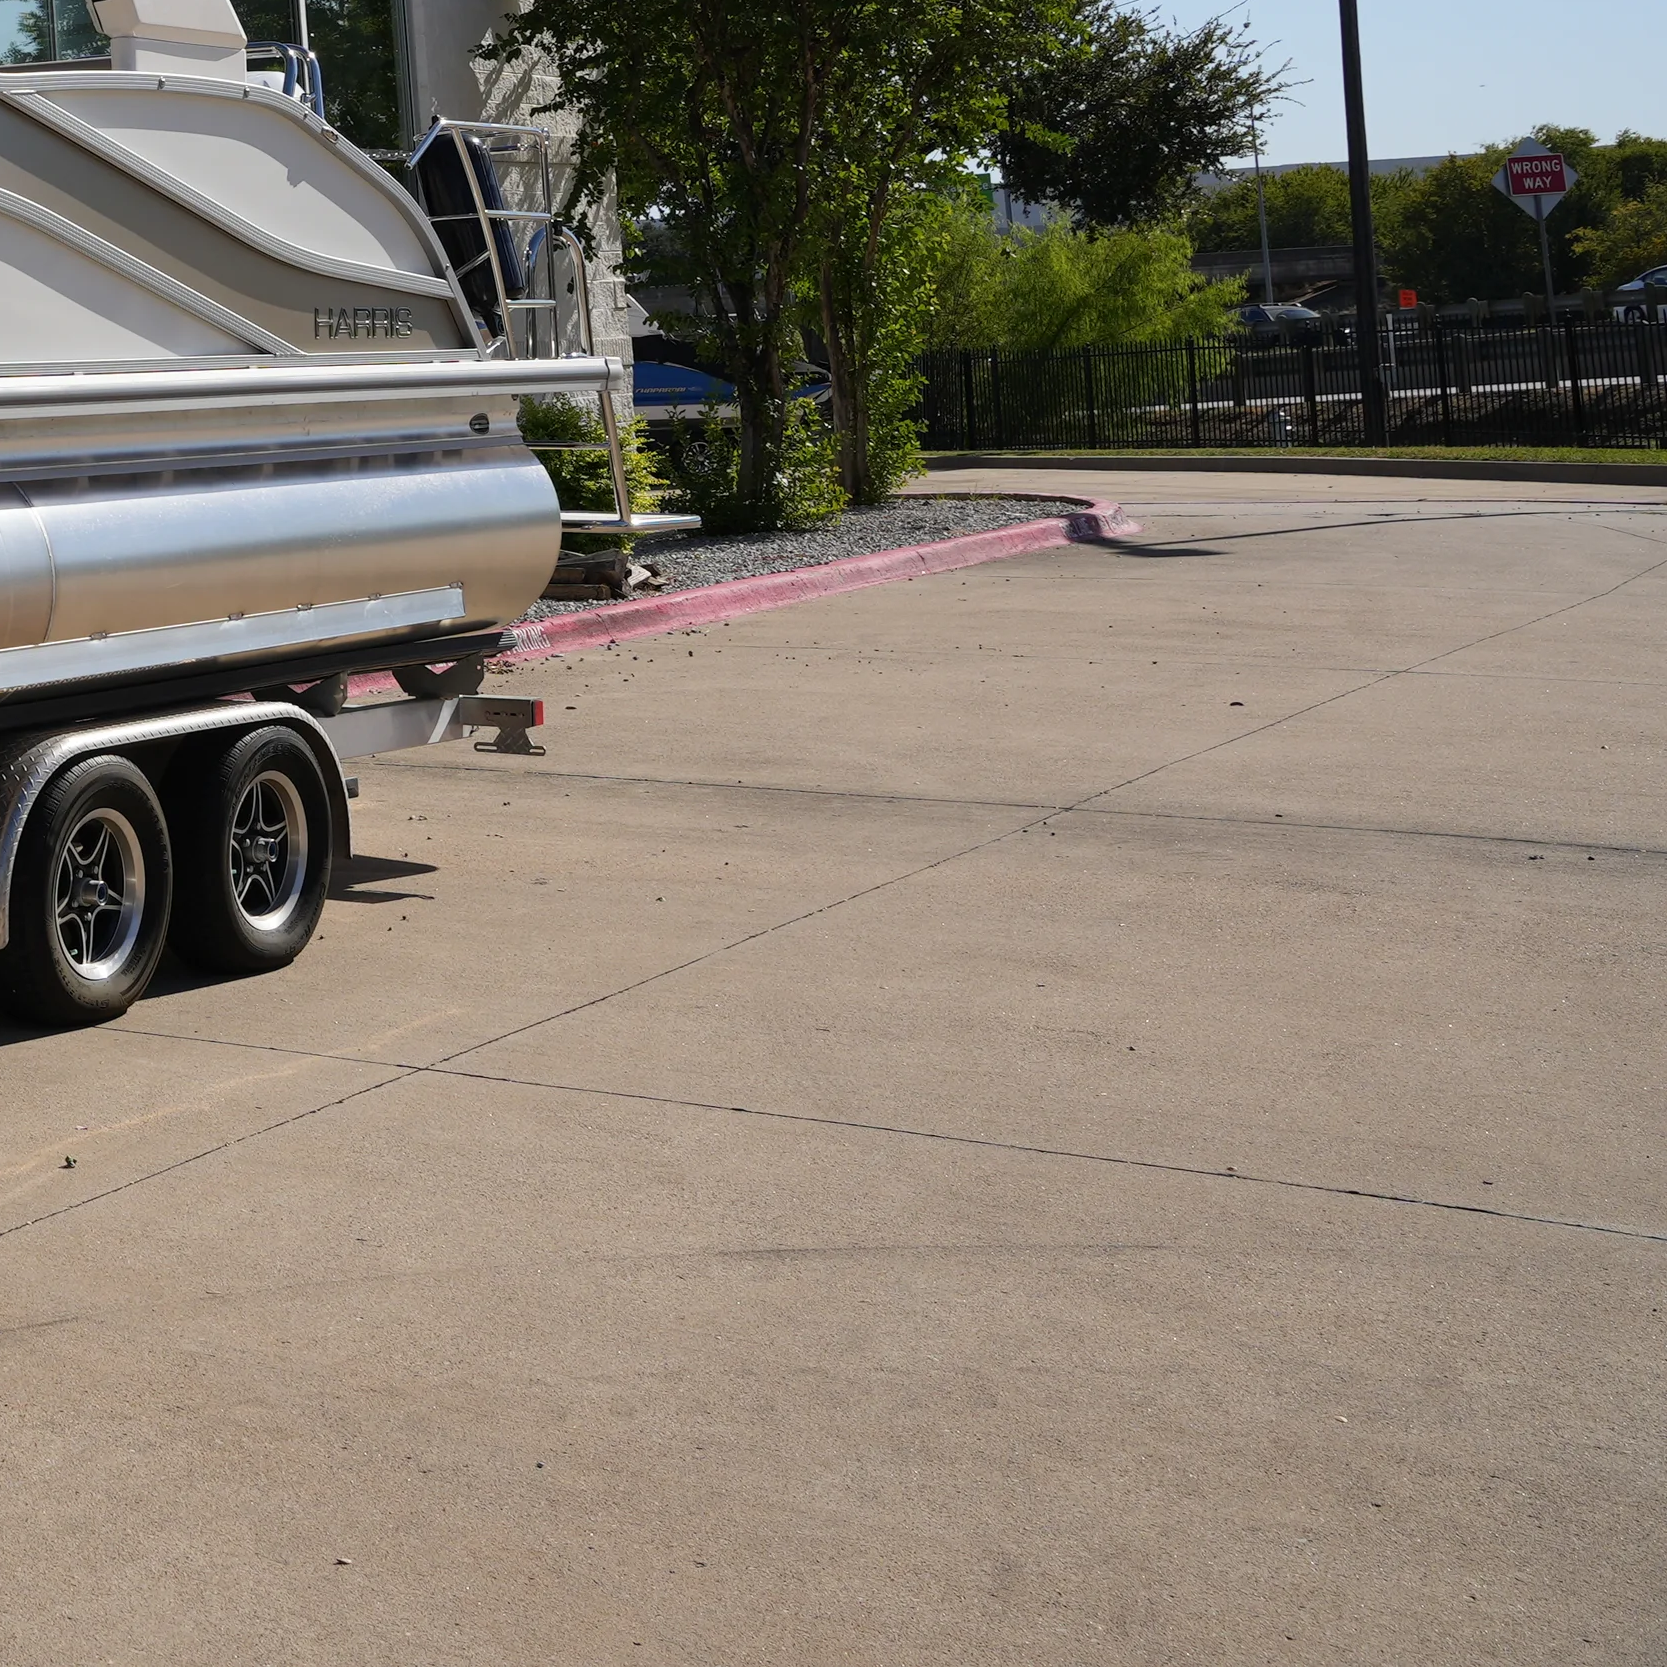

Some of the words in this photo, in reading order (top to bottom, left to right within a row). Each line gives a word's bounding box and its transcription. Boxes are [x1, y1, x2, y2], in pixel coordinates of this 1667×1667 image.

[1511, 159, 1561, 175] WRONG
[1523, 176, 1552, 190] WAY
[314, 307, 413, 339] HARRIS
